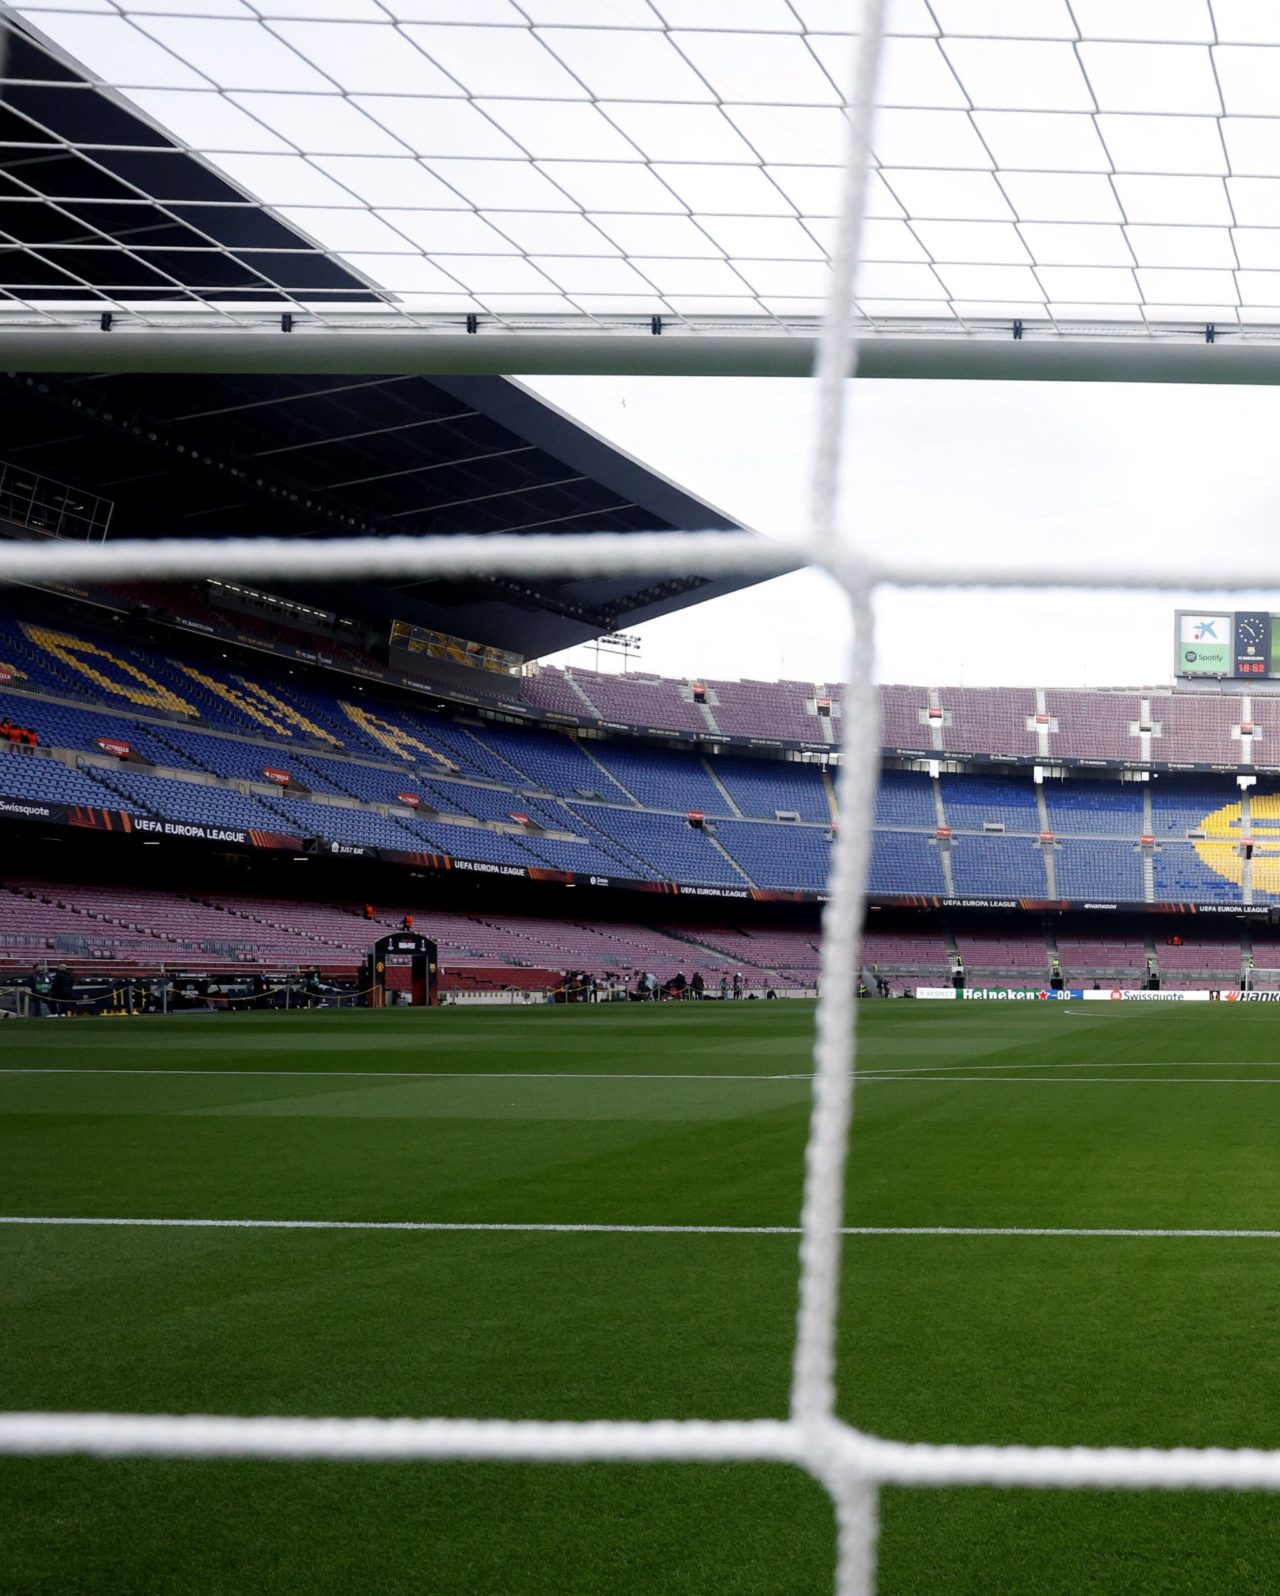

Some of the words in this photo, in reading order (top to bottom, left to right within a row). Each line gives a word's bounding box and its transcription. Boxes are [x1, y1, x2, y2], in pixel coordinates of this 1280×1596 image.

[1198, 654, 1223, 662] Spotify
[0, 801, 49, 815] Swissquote
[135, 818, 162, 833] UEFA
[165, 822, 205, 839] EUROPA
[207, 828, 245, 842] LEAGUE
[454, 860, 473, 871] UEFA
[473, 863, 499, 874] EUROPA
[500, 866, 525, 876] LEAGUE
[680, 886, 696, 895] UEFA
[697, 888, 721, 896] EUROPA
[721, 890, 748, 898] LEAGUE
[963, 989, 1035, 1000] Heineken
[1123, 991, 1184, 1000] Swissquote
